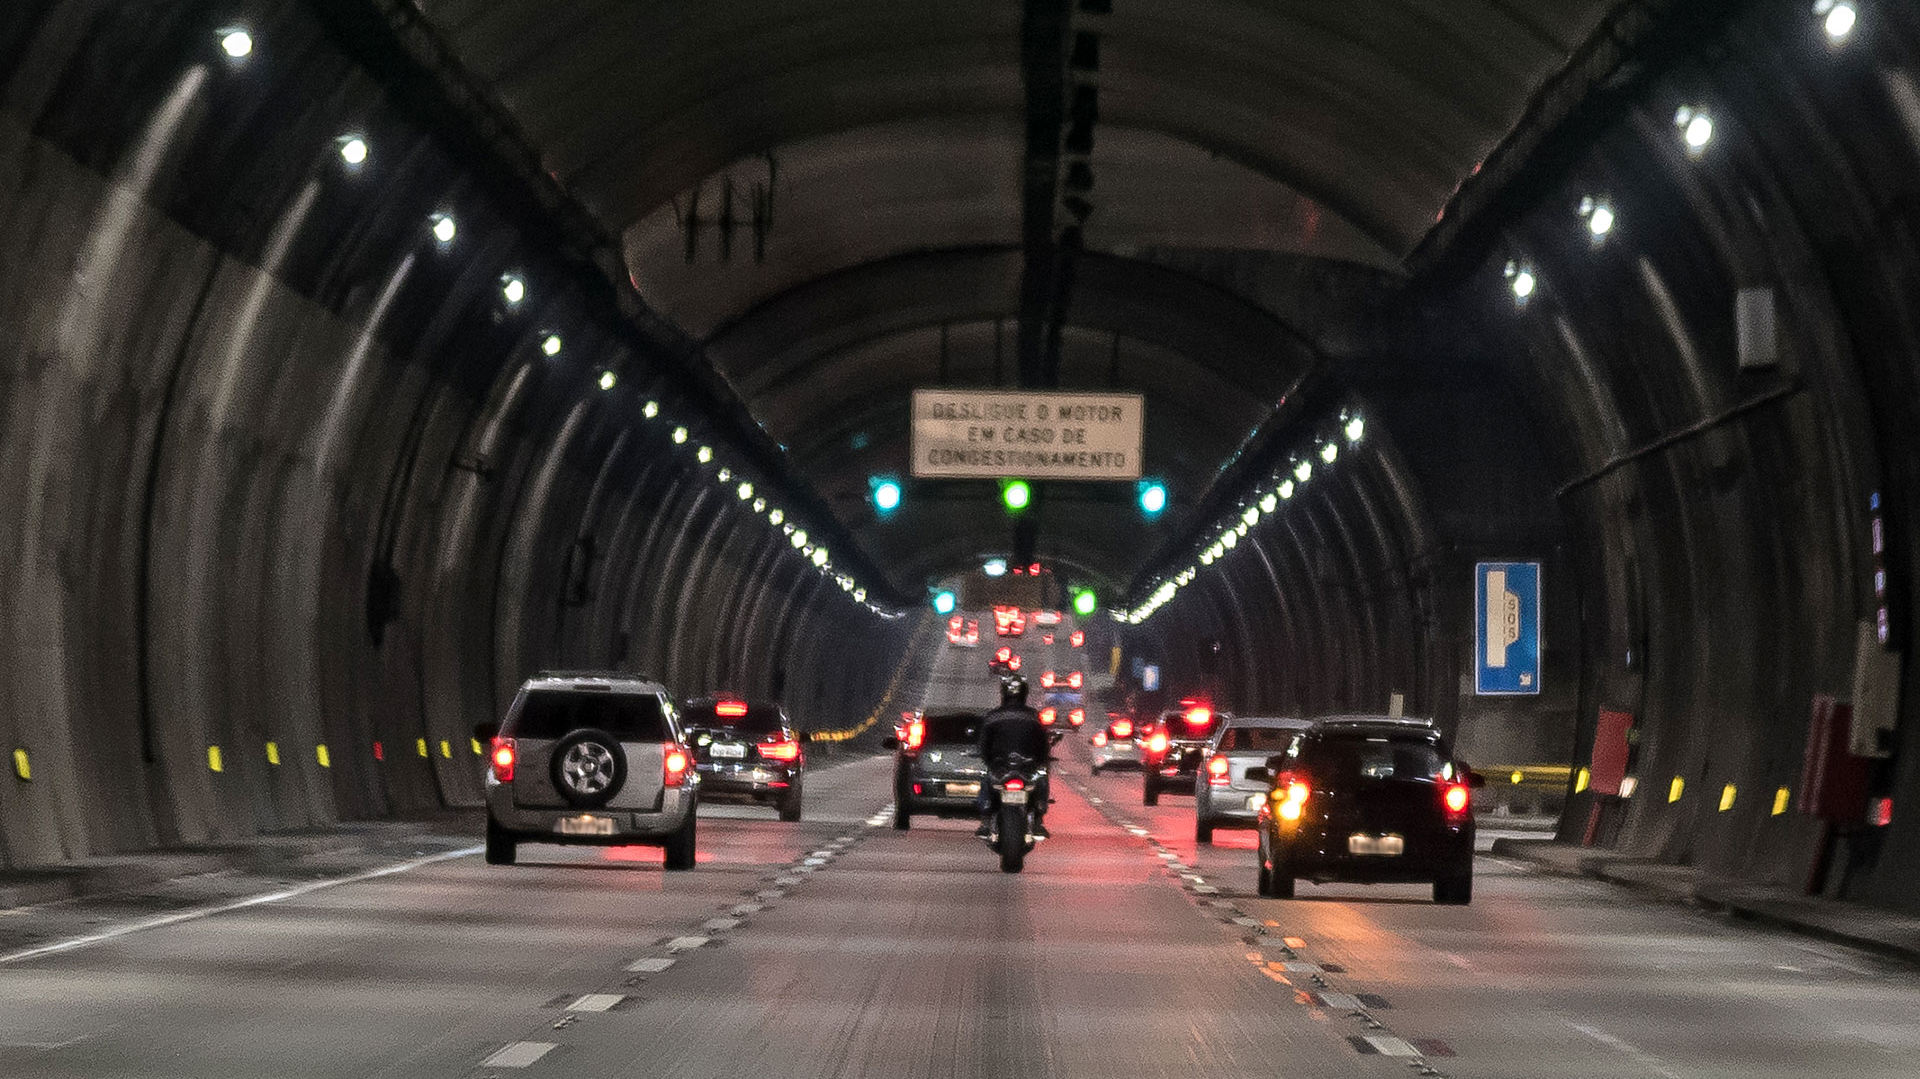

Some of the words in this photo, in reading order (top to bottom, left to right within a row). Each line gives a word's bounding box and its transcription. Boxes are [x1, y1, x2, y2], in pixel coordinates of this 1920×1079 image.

[932, 403, 1026, 420] DESLIGUE
[1036, 404, 1049, 421] O
[1058, 405, 1123, 422] MOTOR
[967, 426, 994, 443] EM
[1003, 427, 1054, 444] CASO
[1062, 428, 1086, 444] DE
[928, 450, 1126, 467] CONGESTIONAMENTO
[1507, 600, 1516, 638] SOS
